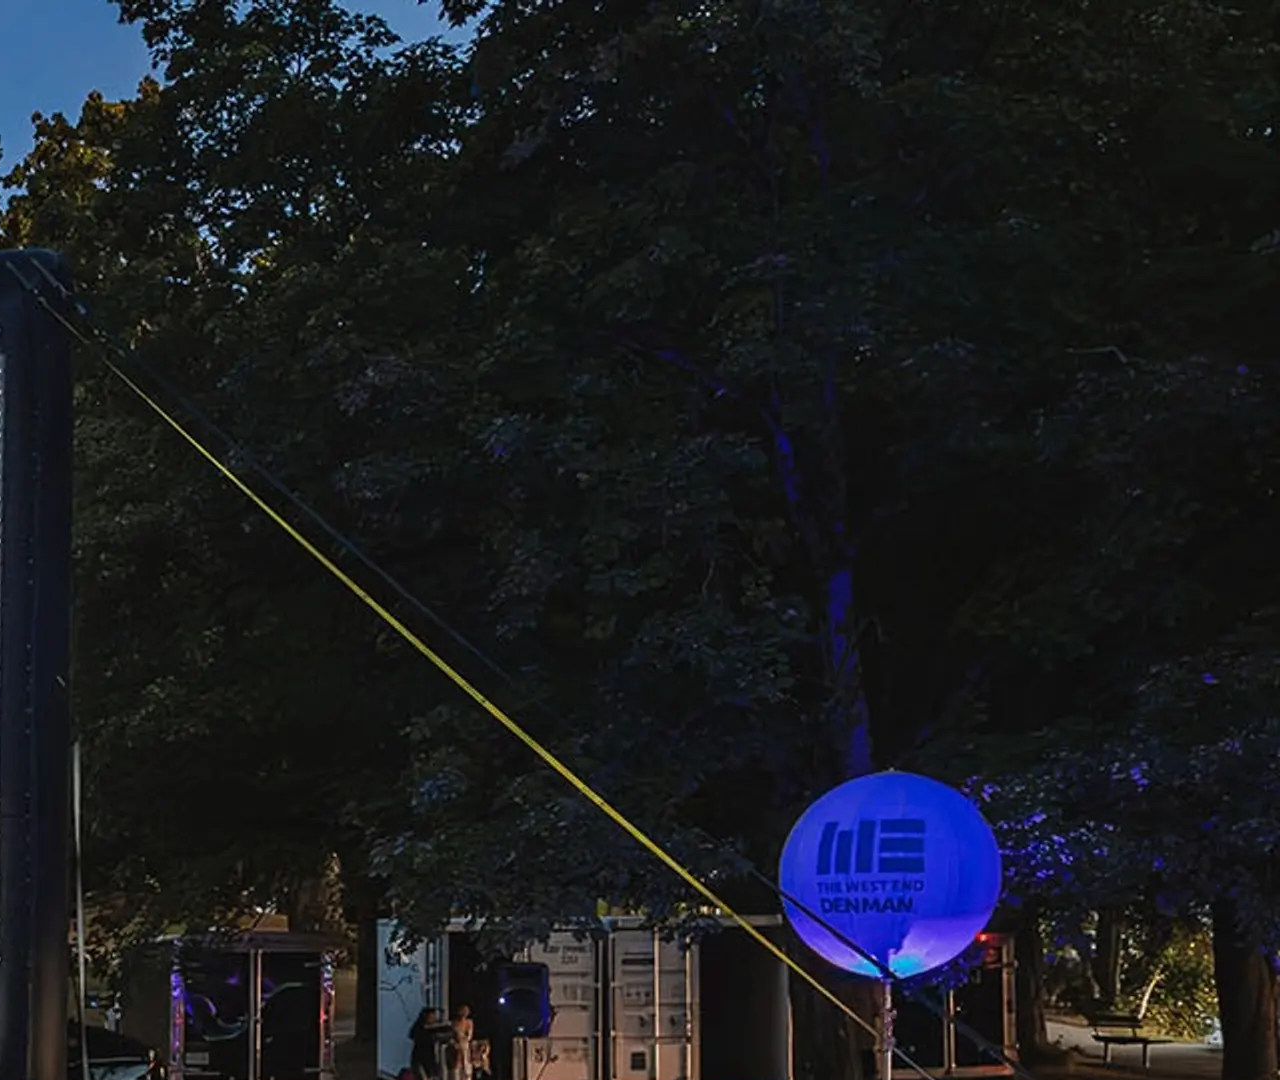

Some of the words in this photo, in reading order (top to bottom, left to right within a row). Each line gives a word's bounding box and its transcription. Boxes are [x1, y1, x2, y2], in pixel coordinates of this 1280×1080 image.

[816, 881, 843, 893] THE
[844, 880, 887, 893] WEST
[891, 879, 925, 893] END
[821, 897, 913, 914] DENMAN
